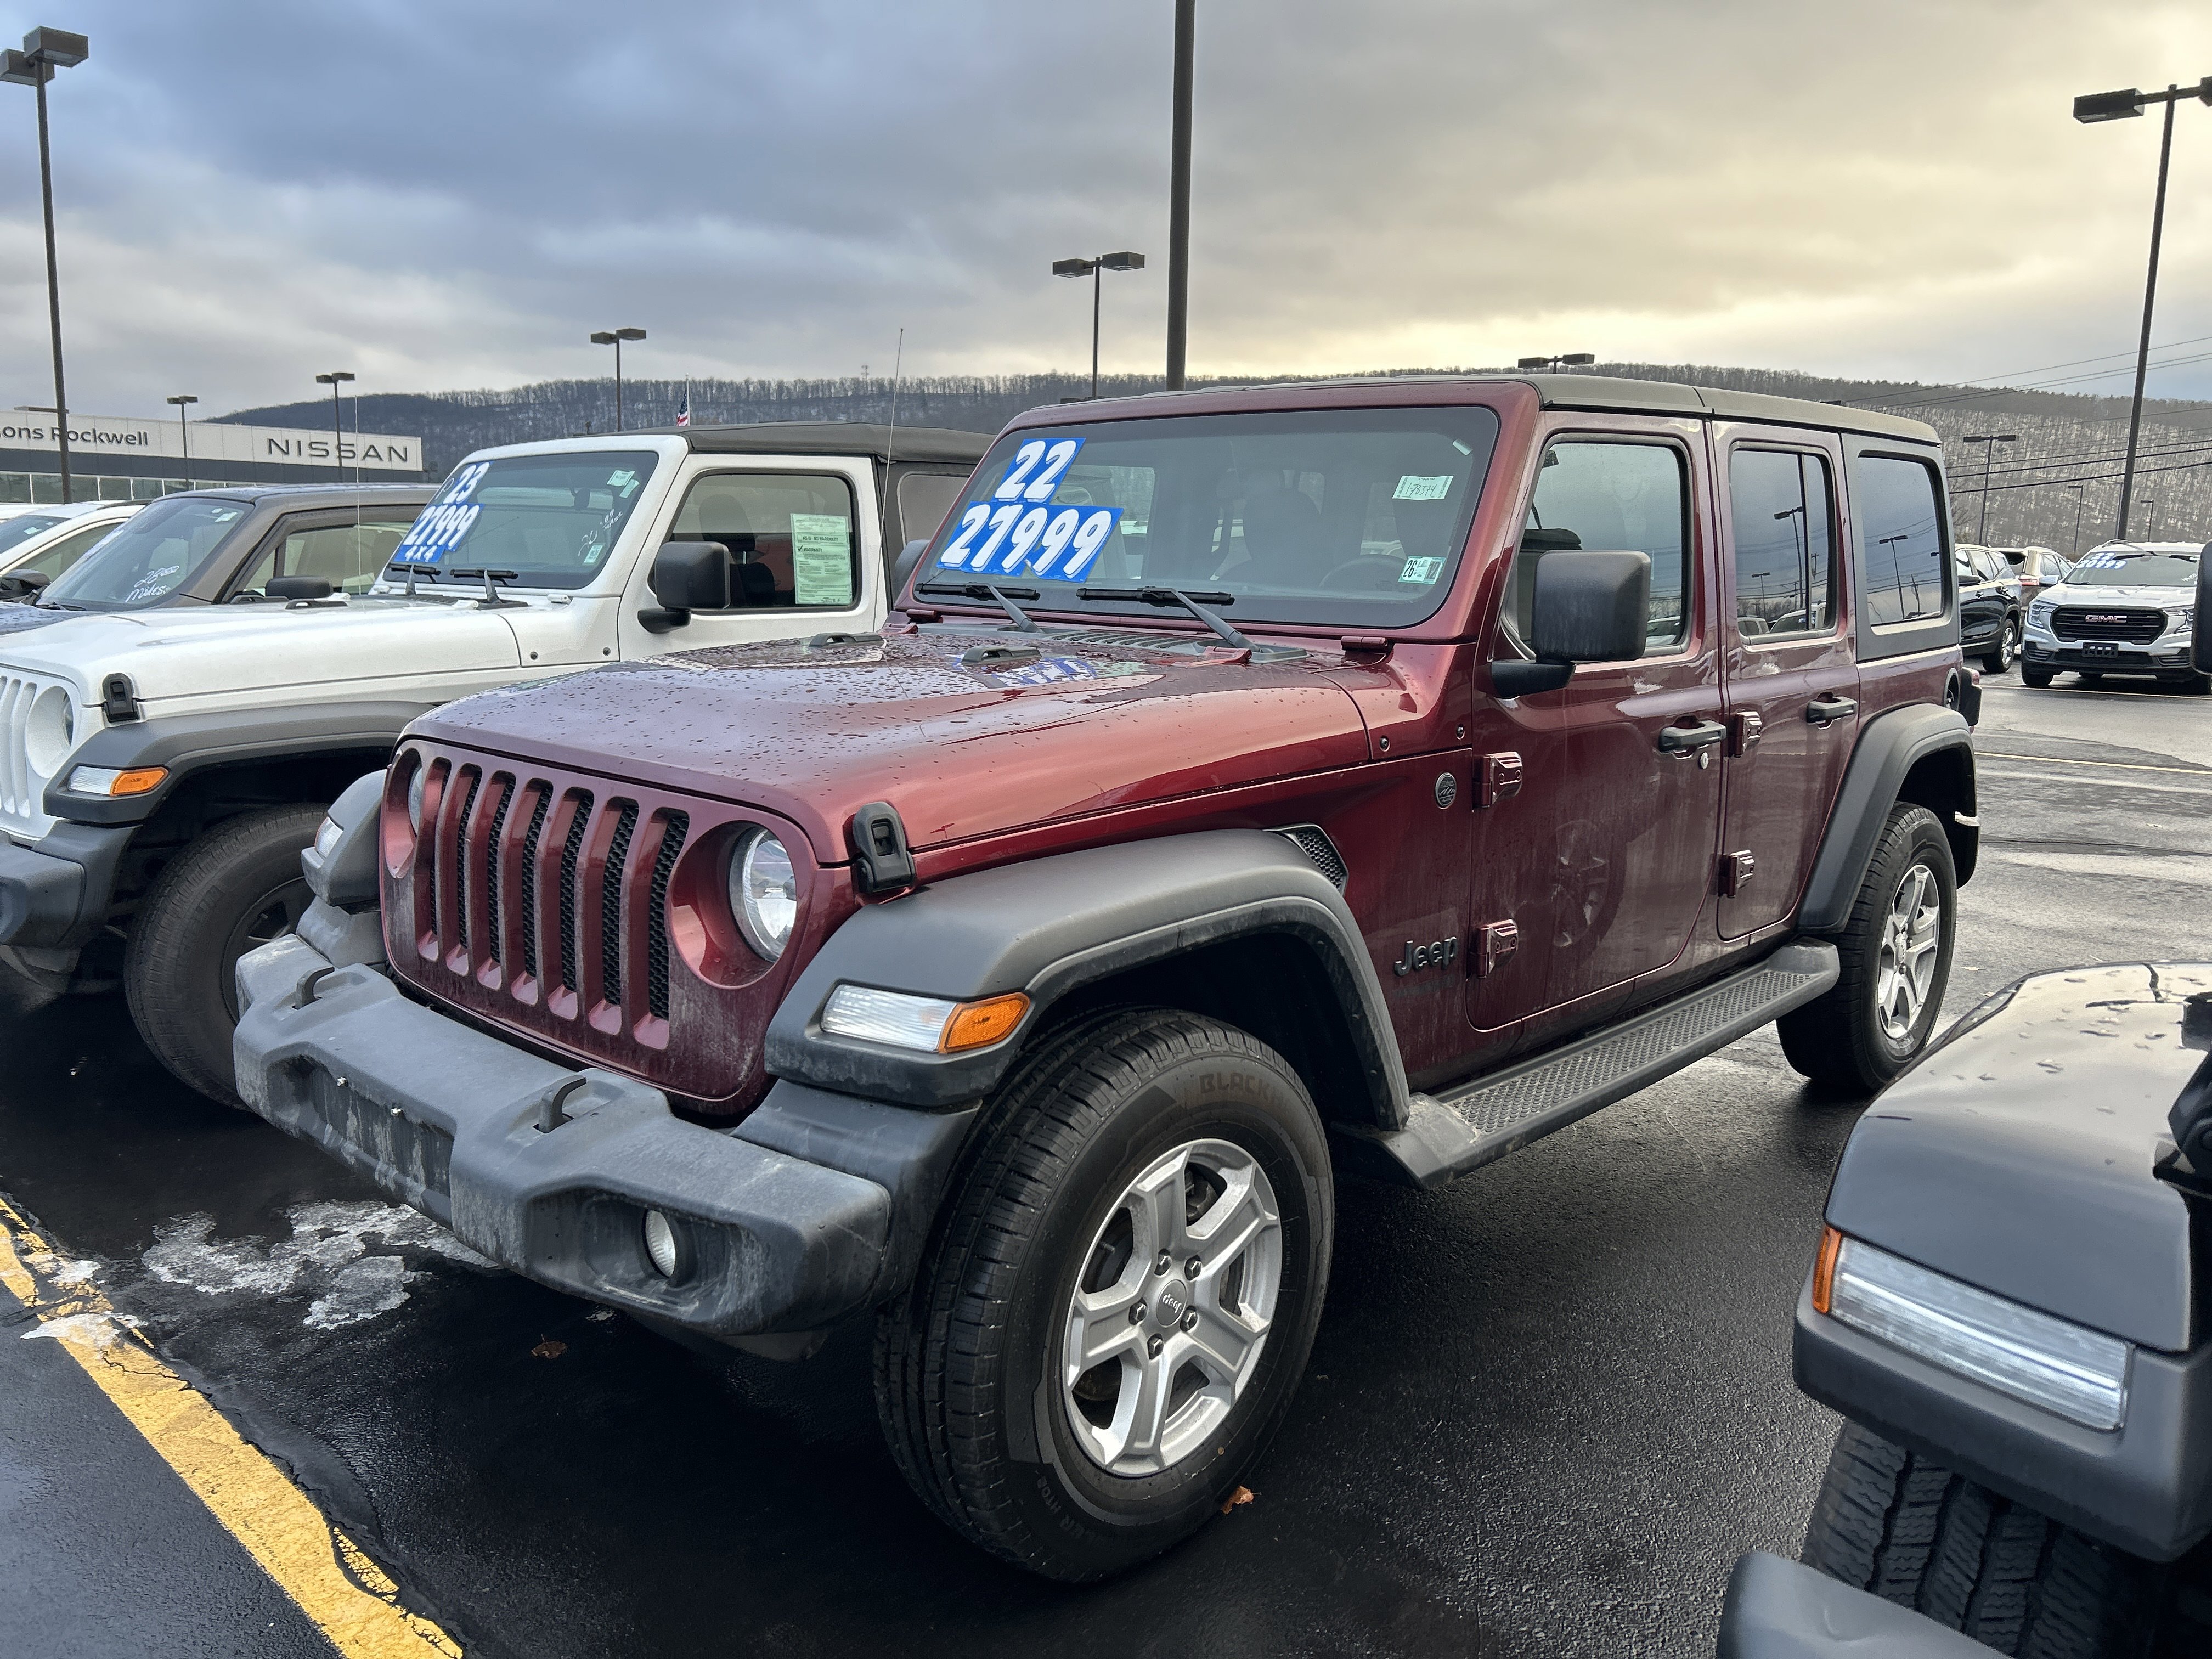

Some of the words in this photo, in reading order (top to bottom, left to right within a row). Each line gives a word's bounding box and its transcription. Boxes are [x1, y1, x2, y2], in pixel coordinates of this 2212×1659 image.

[0, 425, 44, 439] ons
[267, 438, 408, 462] NISSAN
[443, 462, 490, 504] 23
[995, 440, 1077, 503] 22
[403, 504, 480, 550] 27999
[940, 503, 1113, 579] 27999
[1403, 560, 1418, 578] 26
[2085, 614, 2128, 623] GMC
[1394, 936, 1458, 976] Jeep
[1162, 1294, 1182, 1313] Jeep
